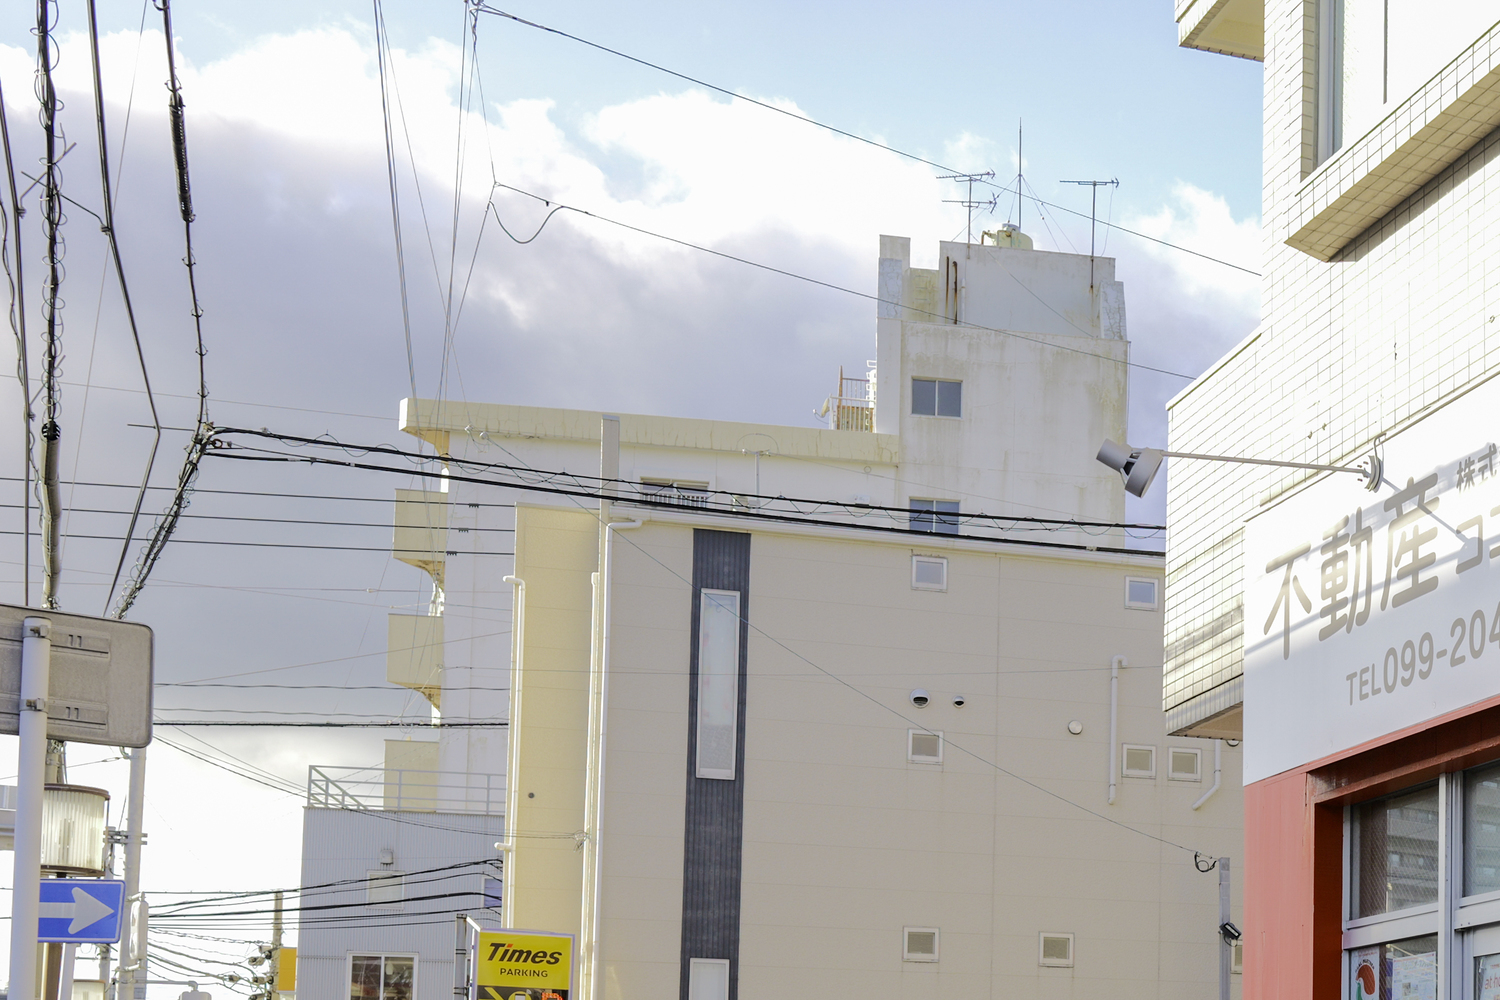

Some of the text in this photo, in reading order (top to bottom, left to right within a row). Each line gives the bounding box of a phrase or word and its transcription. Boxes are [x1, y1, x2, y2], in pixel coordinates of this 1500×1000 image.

[1263, 472, 1440, 661] 不動産
[487, 942, 563, 965] Times
[499, 967, 549, 978] PARKING
